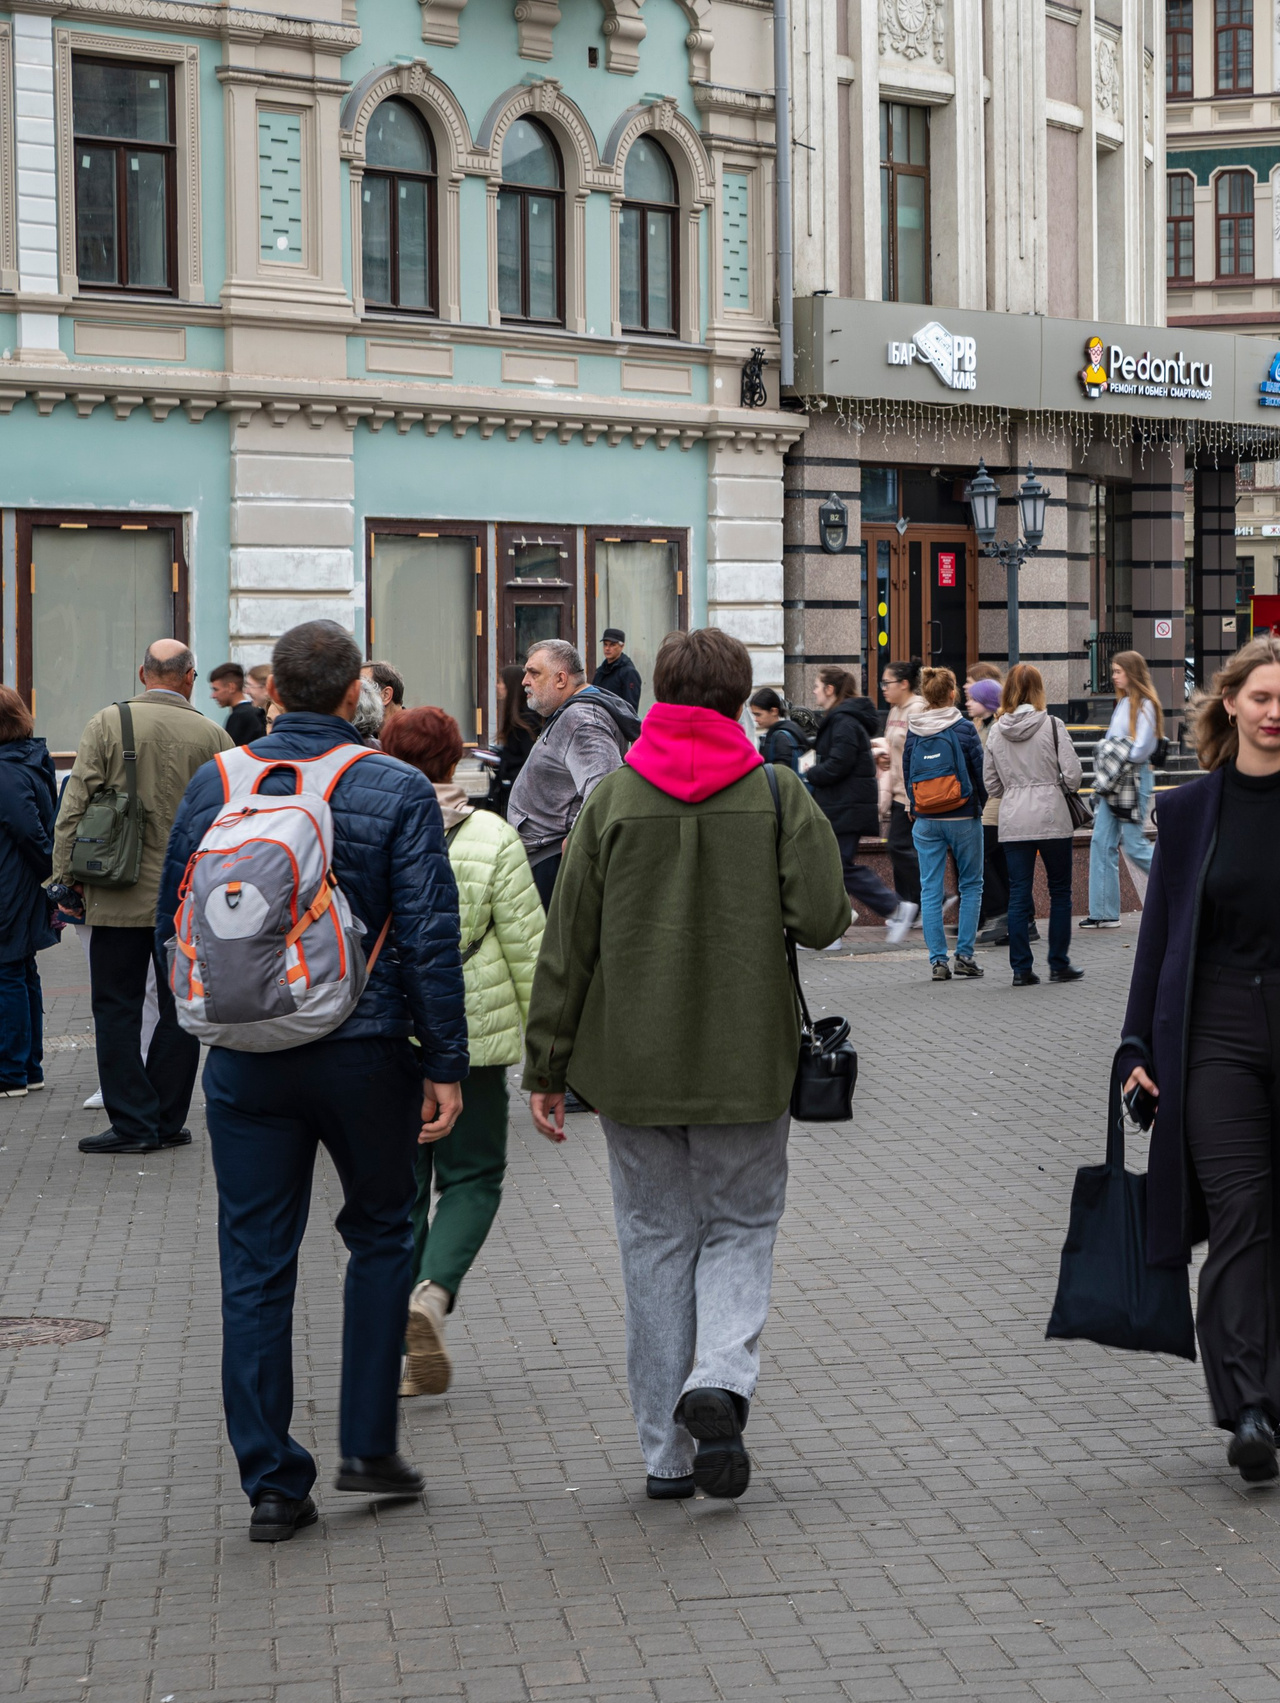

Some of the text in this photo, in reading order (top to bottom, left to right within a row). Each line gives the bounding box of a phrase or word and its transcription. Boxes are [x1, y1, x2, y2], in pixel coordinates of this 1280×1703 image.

[890, 341, 917, 365] БАР
[1109, 345, 1213, 387] Pedant.ru
[953, 371, 977, 390] КЛАБ
[1110, 382, 1212, 400] РЕМОНТ И ОБМЕН СМАРТФОНОВ
[830, 513, 840, 521] 82
